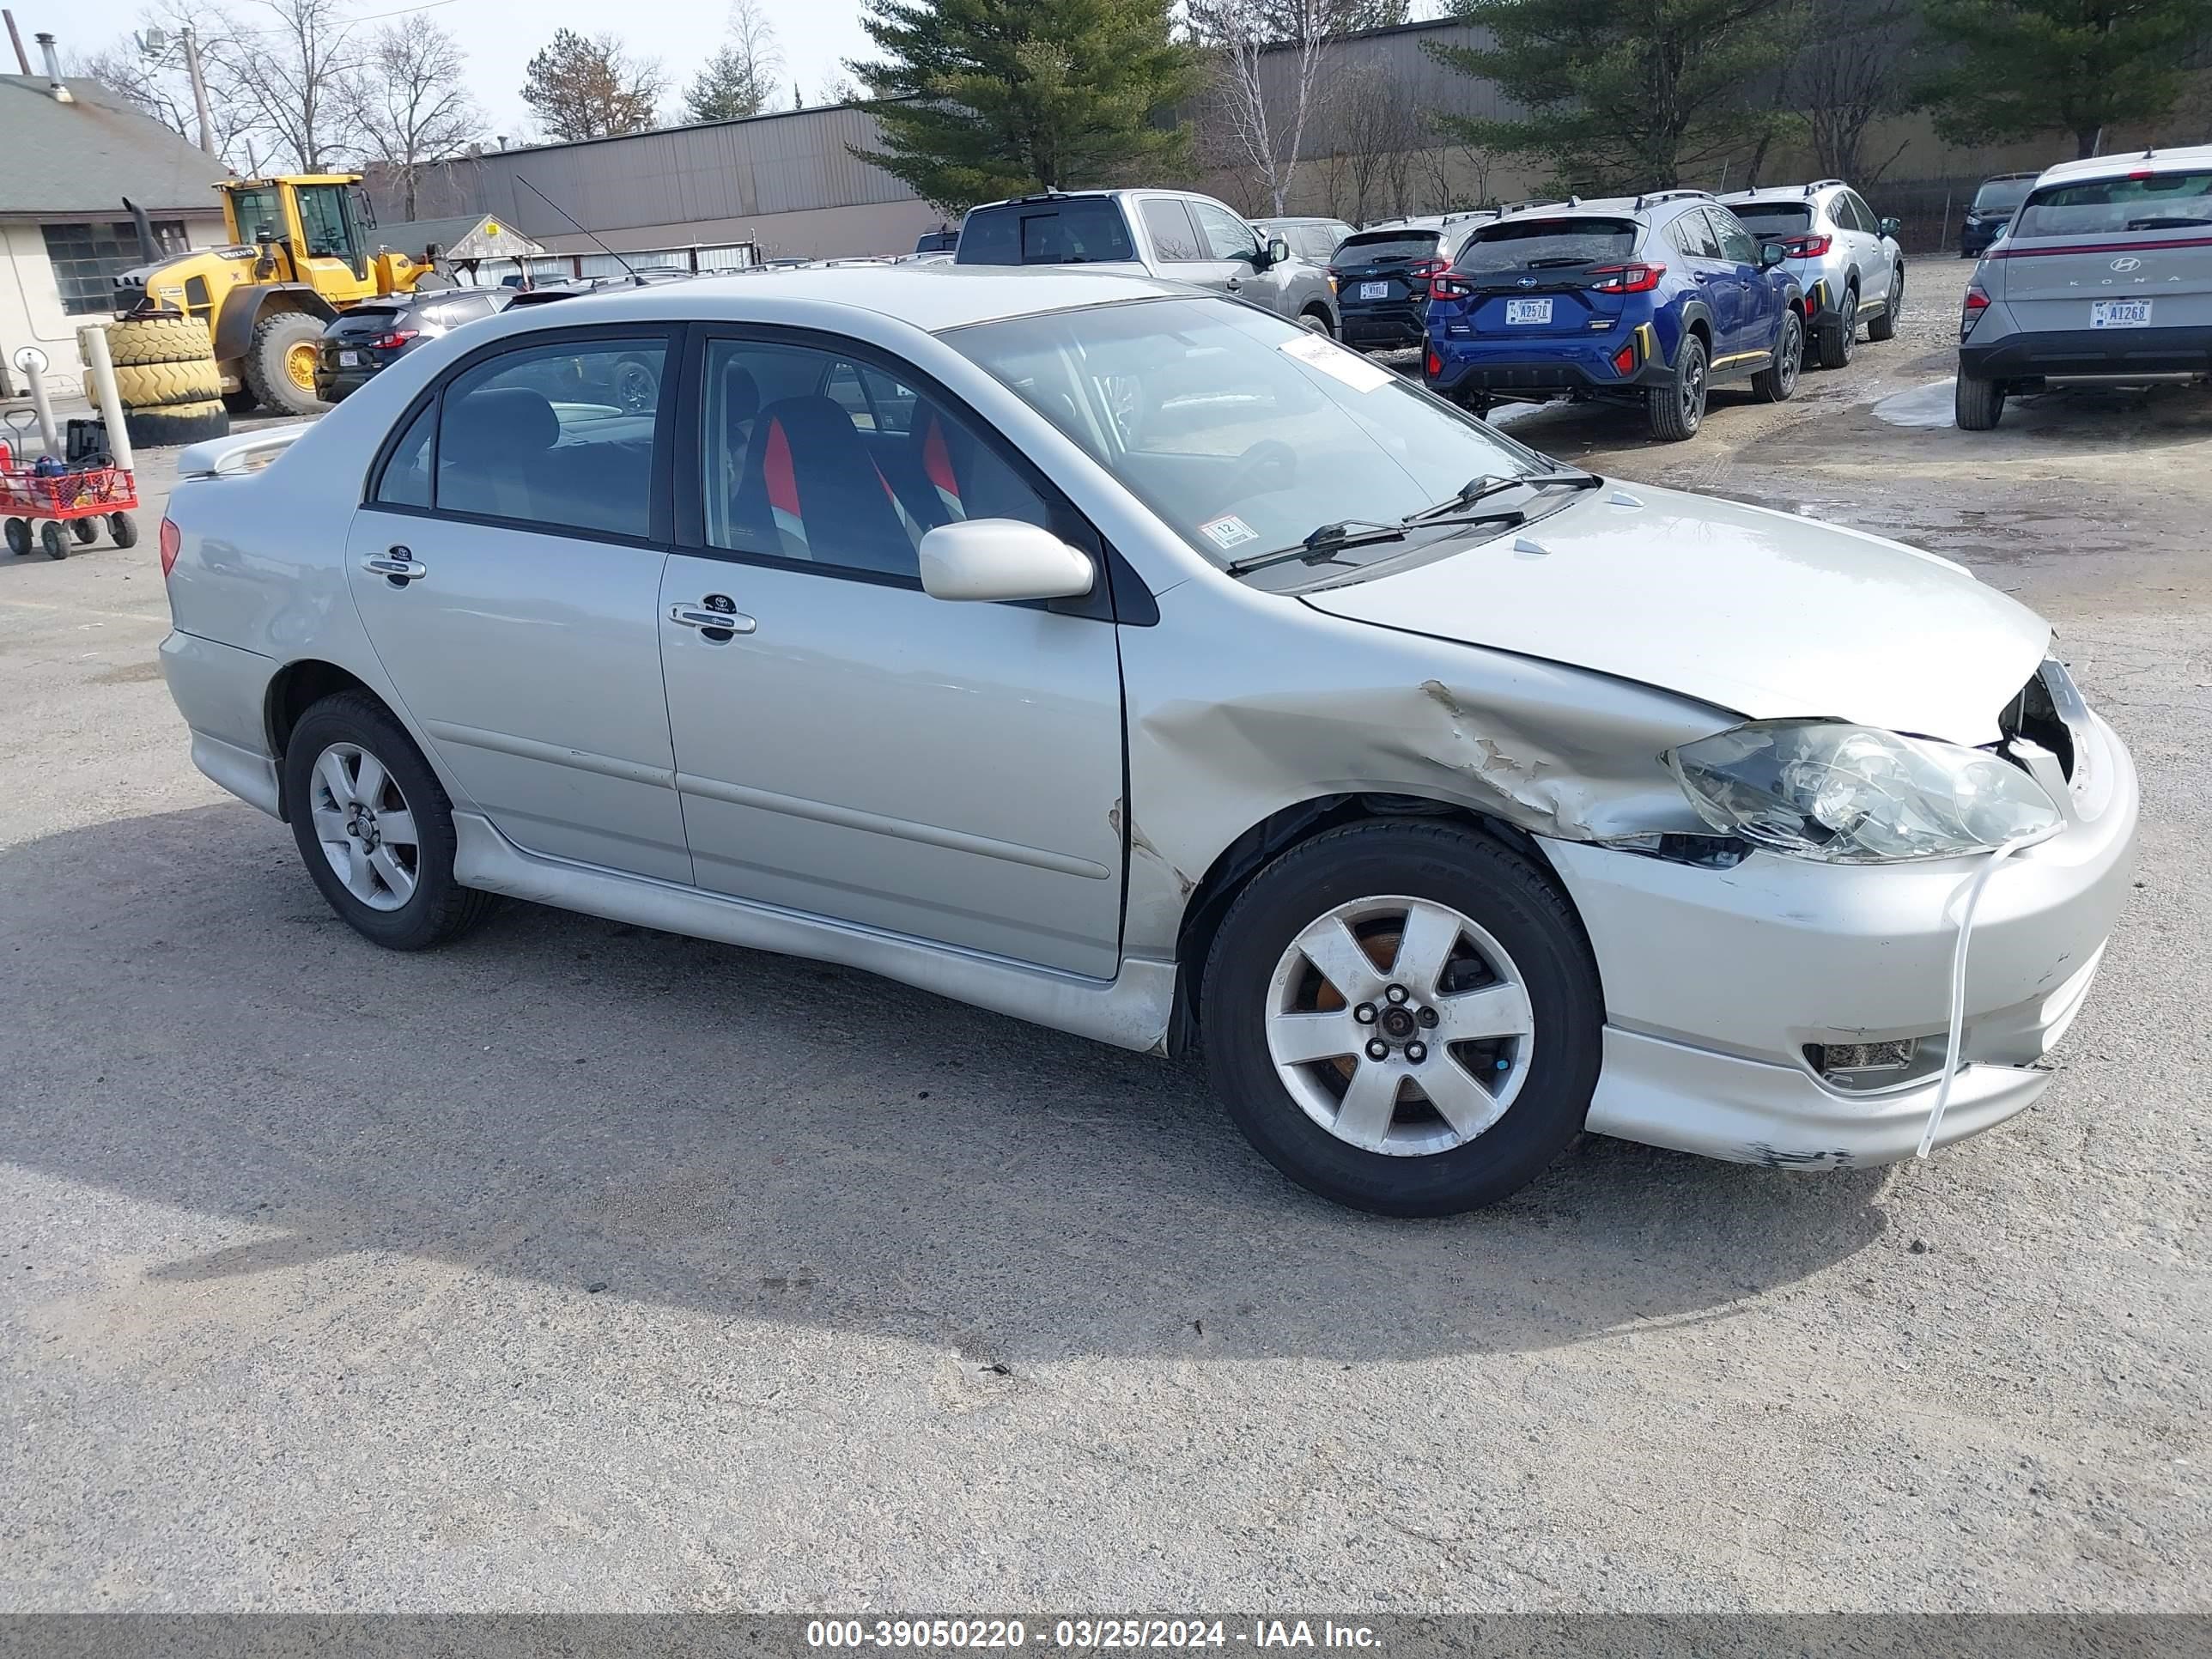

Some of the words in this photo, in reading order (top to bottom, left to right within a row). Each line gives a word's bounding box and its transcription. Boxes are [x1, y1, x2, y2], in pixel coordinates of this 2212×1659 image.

[220, 249, 254, 258] VOLVO
[2069, 276, 2180, 286] KONA
[2110, 306, 2145, 320] A1268
[1218, 524, 1235, 534] 12
